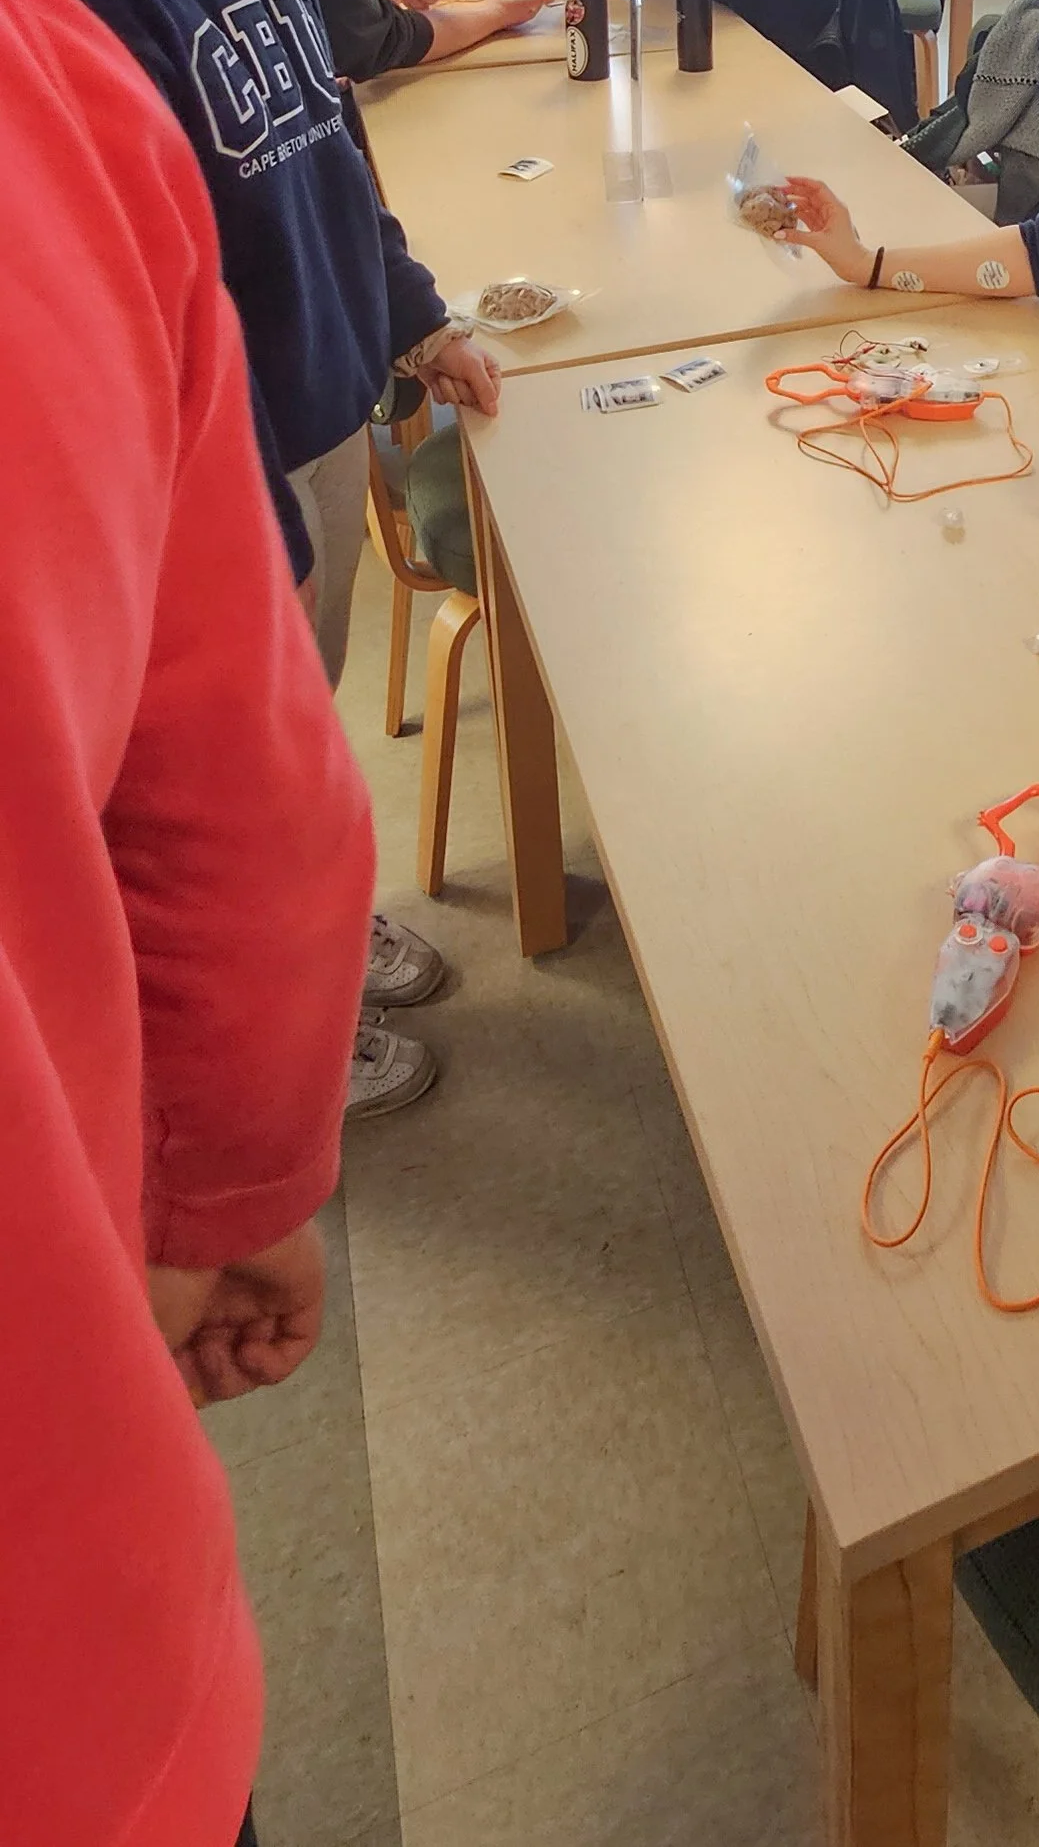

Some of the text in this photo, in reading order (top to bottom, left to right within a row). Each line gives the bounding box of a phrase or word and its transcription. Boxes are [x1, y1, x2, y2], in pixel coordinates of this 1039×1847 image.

[568, 30, 577, 72] HALIFAX
[239, 150, 277, 179] CAPE
[307, 113, 342, 144] UNIVE
